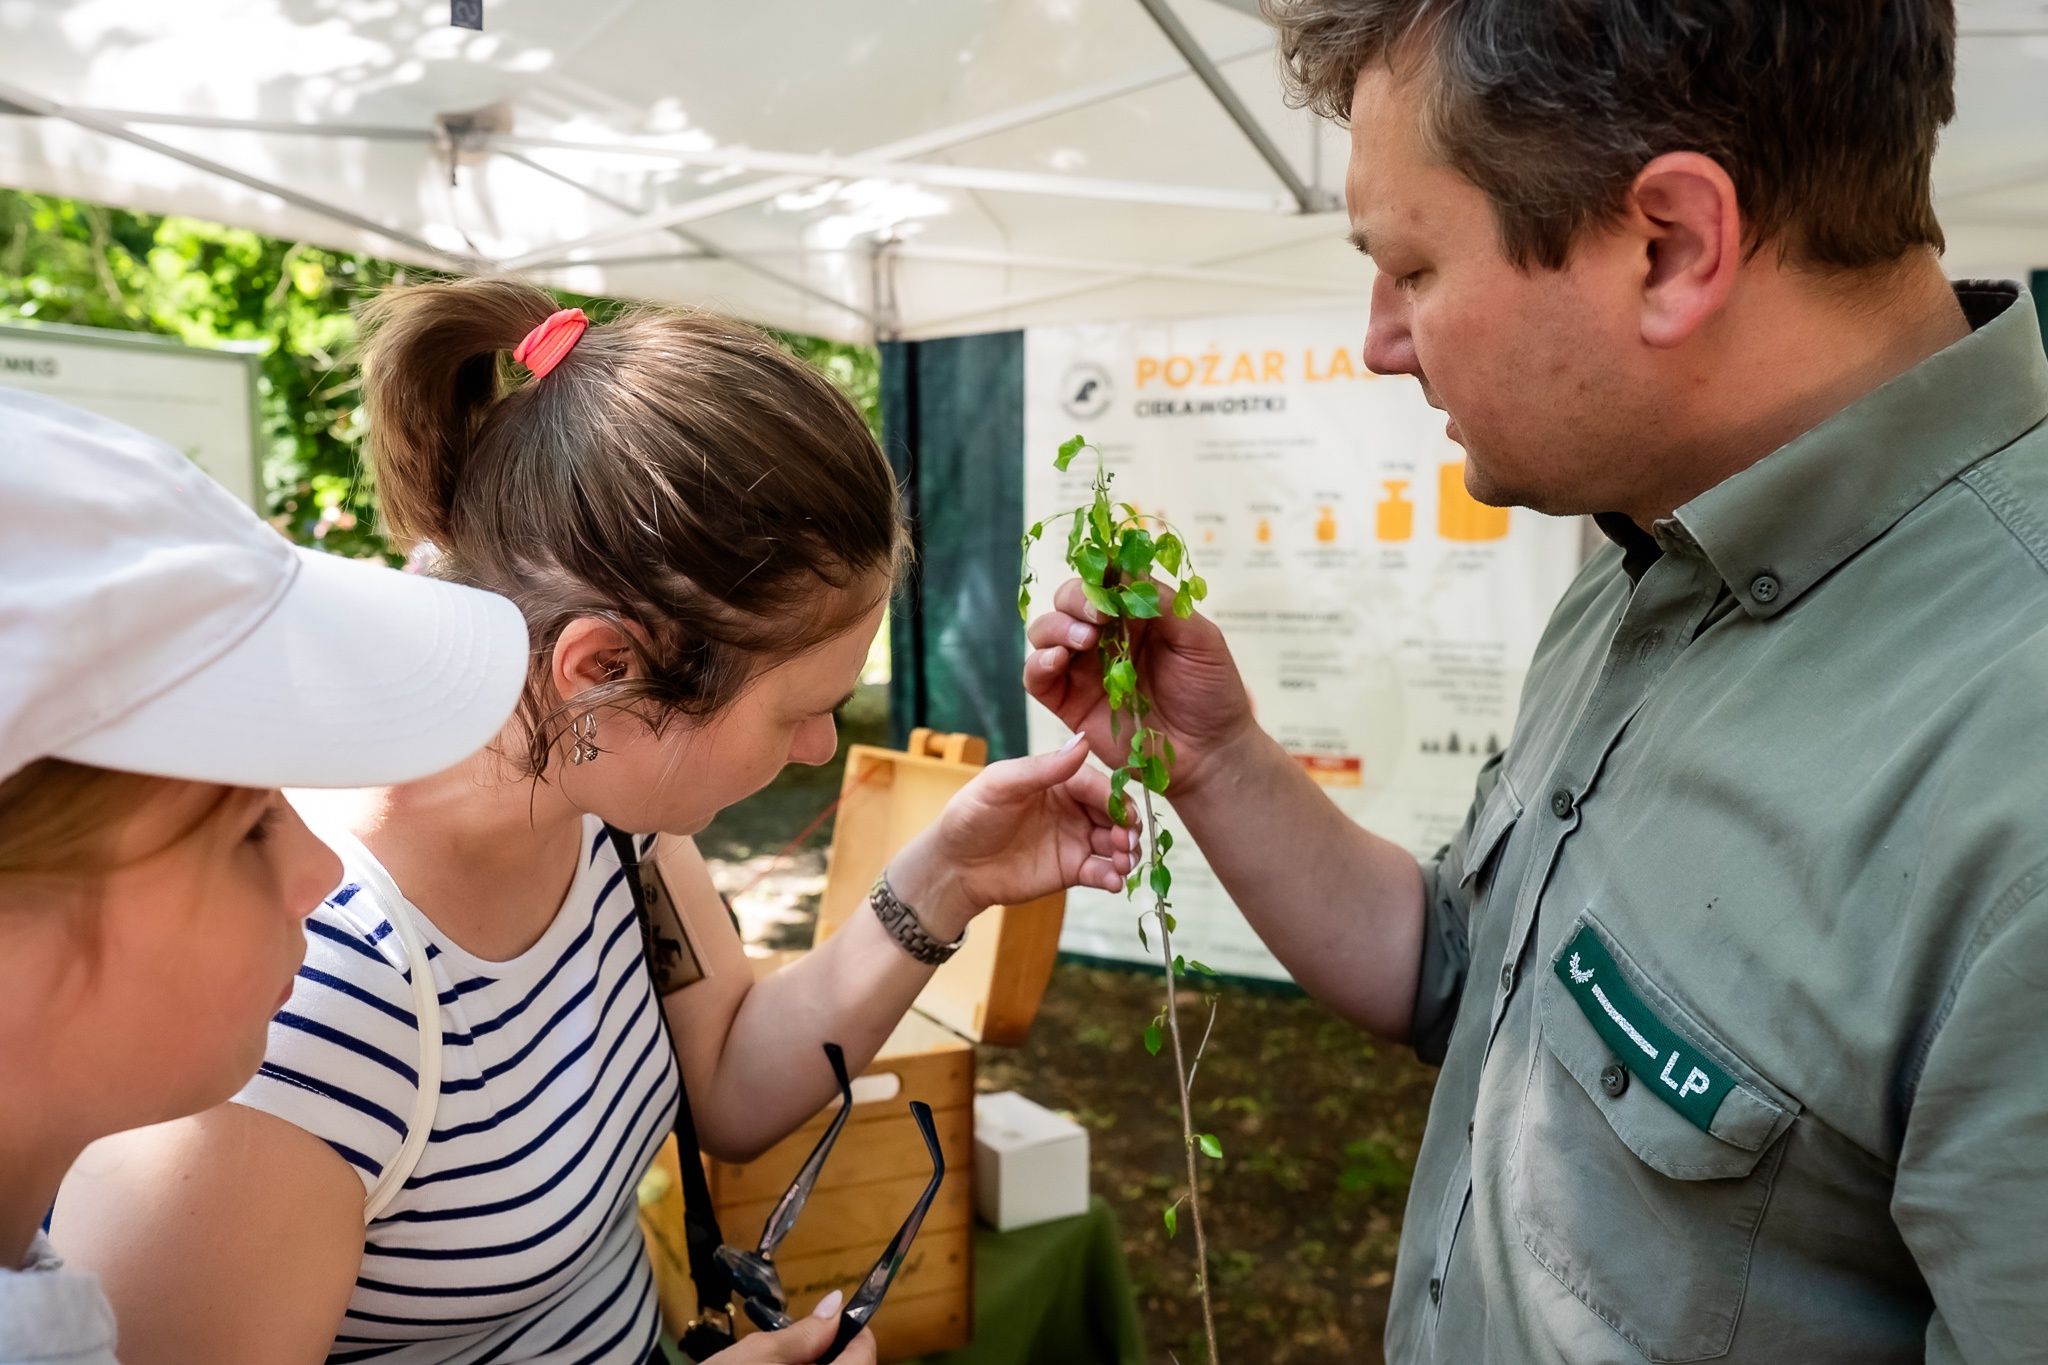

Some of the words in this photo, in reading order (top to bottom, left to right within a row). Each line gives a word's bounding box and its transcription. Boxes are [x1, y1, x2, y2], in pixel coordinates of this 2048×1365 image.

[1135, 342, 1286, 390] POŻAR
[1302, 346, 1381, 382] LA
[1660, 1051, 1709, 1097] LP
